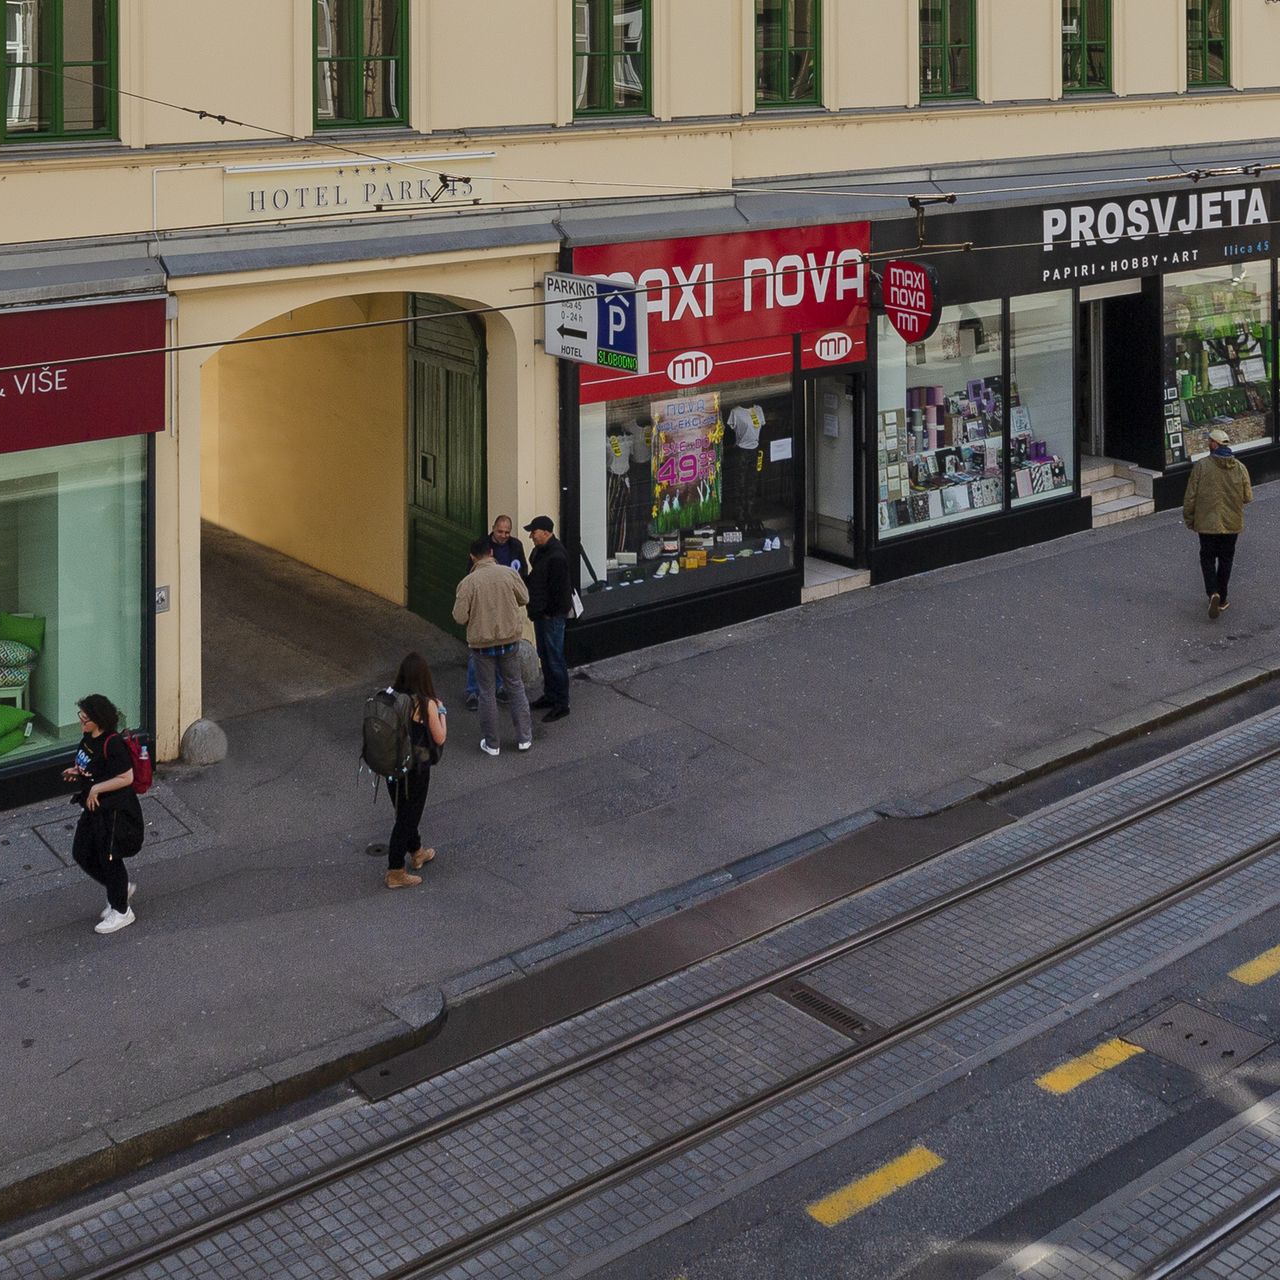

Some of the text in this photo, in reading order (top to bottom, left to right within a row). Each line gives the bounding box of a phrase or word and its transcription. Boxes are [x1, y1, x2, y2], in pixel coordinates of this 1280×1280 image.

[248, 185, 348, 213] HOTEL
[363, 178, 433, 204] PARK
[1043, 188, 1269, 252] PROSVJETA
[1224, 243, 1253, 257] Ilica
[1042, 249, 1199, 282] PAPIRI HOBBY ART
[547, 277, 595, 298] PARKING
[588, 248, 865, 322] AXI NOVA
[608, 304, 626, 346] P
[560, 344, 583, 358] HOTEL
[598, 350, 638, 370] SLOBODNO
[13, 365, 68, 395] VIŠE
[665, 398, 706, 416] NOVA
